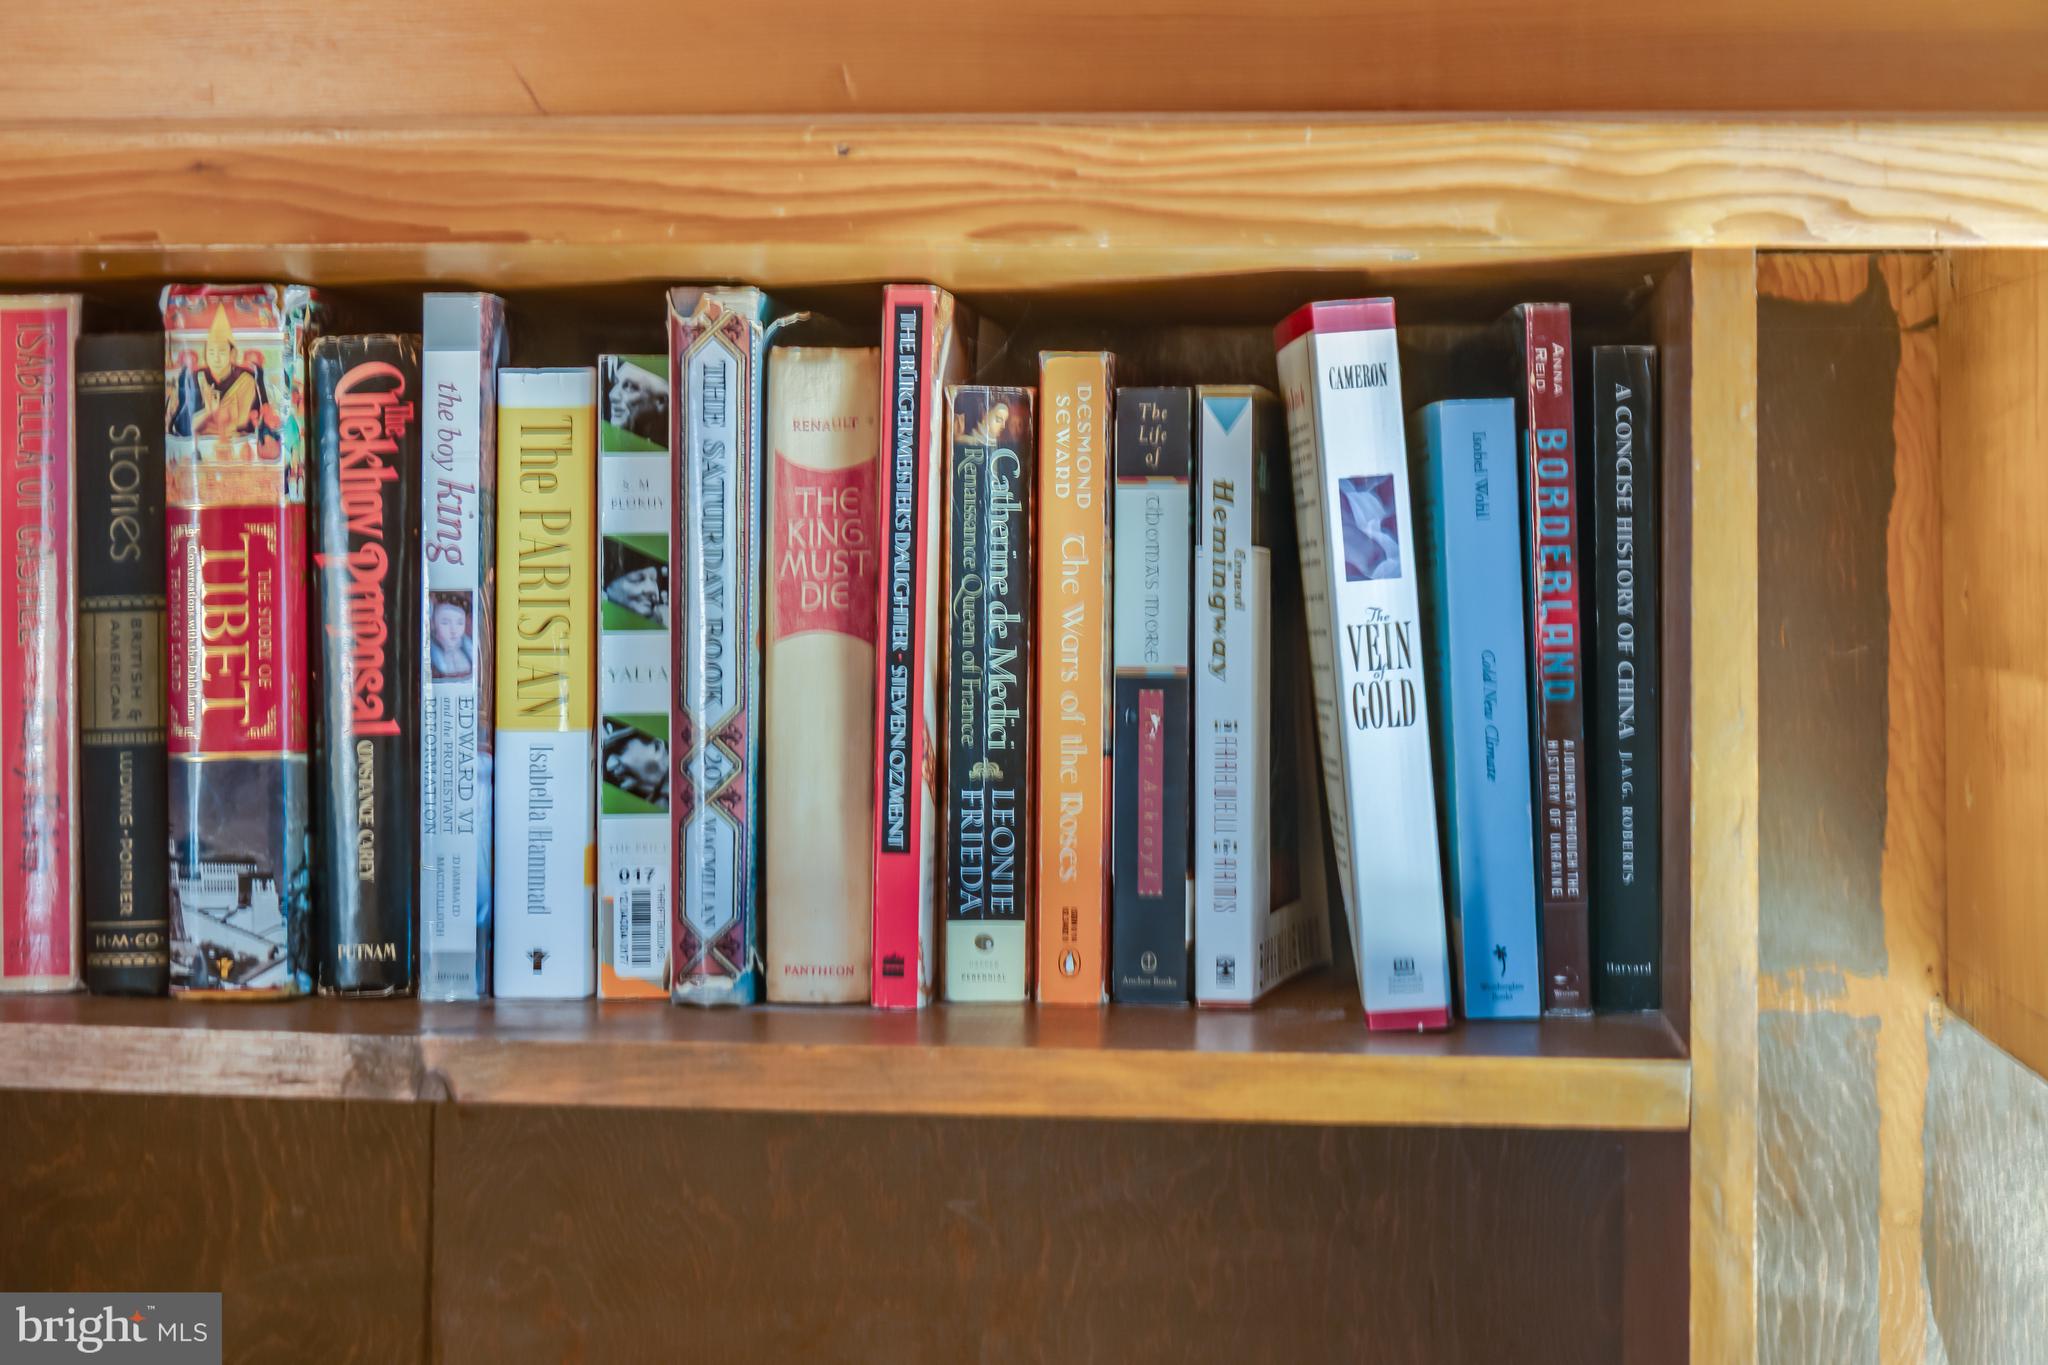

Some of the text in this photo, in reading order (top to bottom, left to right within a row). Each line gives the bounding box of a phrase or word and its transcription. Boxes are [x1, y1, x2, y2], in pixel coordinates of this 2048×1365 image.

[900, 310, 917, 354] THE
[1535, 347, 1547, 393] REID
[1552, 342, 1564, 397] ANNA
[15, 322, 55, 468] ISABELLA
[1139, 402, 1168, 423] The
[1328, 362, 1388, 390] CAMERON
[1615, 383, 1632, 401] A
[334, 361, 405, 540] Chekhov
[385, 401, 415, 439] The
[792, 416, 859, 433] RENAULT
[1055, 394, 1071, 499] SEWARD
[1077, 386, 1092, 509] DESMOND
[1138, 423, 1168, 447] Life
[1144, 446, 1164, 471] of
[1616, 405, 1633, 511] CONCISE
[109, 424, 155, 562] stories
[426, 382, 476, 566] the boy king
[795, 486, 860, 518] THE
[517, 415, 573, 718] The PARISIAN
[702, 361, 726, 706] THE SATURDAY BOOK
[780, 548, 868, 579] MUST
[787, 518, 866, 550] KING
[1061, 535, 1089, 595] The
[1537, 428, 1576, 704] BORDERLAND
[1617, 516, 1634, 620] HISTORY
[801, 580, 850, 613] DIE
[892, 533, 912, 652] DAUGHTER
[953, 446, 985, 747] Renaissance Queen of France
[986, 447, 1024, 751] Catherine de Medici
[1207, 478, 1235, 683] Hemingway
[1233, 548, 1247, 612] Ernest
[1366, 606, 1391, 622] The
[109, 619, 122, 723] AMERICAN
[130, 618, 144, 699] BRITISH
[171, 567, 182, 693] THOMAS LAIRD
[187, 545, 200, 722] Conversations with the Dalai Lama
[201, 532, 250, 727] TIBET
[258, 570, 273, 689] THE STORY OF
[1060, 603, 1085, 682] Wars
[1346, 620, 1412, 673] VEIN
[1373, 663, 1386, 681] of
[1618, 622, 1634, 656] OF
[890, 664, 909, 749] STEVEN
[1059, 690, 1087, 726] of
[1352, 678, 1416, 731] GOLD
[1617, 661, 1635, 740] CHINA
[424, 696, 439, 835] REFORMATION
[443, 697, 456, 834] and the PROTESTANT
[458, 696, 474, 836] EDWARD VI
[704, 754, 723, 781] 20
[888, 750, 906, 850] OZMENT
[1059, 735, 1088, 785] the
[120, 751, 133, 916] LUDWIG POIRIER
[357, 740, 374, 883] CONSTANCE CAREY
[527, 744, 555, 915] Isabella Hammad
[960, 788, 985, 914] FRIEDA
[990, 787, 1015, 915] LEONIE
[1058, 792, 1084, 881] Roses
[1547, 740, 1563, 897] HISTORY OF UKRAINE
[1563, 739, 1580, 897] A JOURNEY THROUGH THE
[1622, 805, 1634, 886] ROBERTS
[702, 817, 717, 929] MACMILLAN
[337, 943, 397, 961] PUTNAM
[784, 963, 856, 977] PANTHEON
[1122, 976, 1177, 987] Anchor Books
[1606, 962, 1652, 976] Harvard
